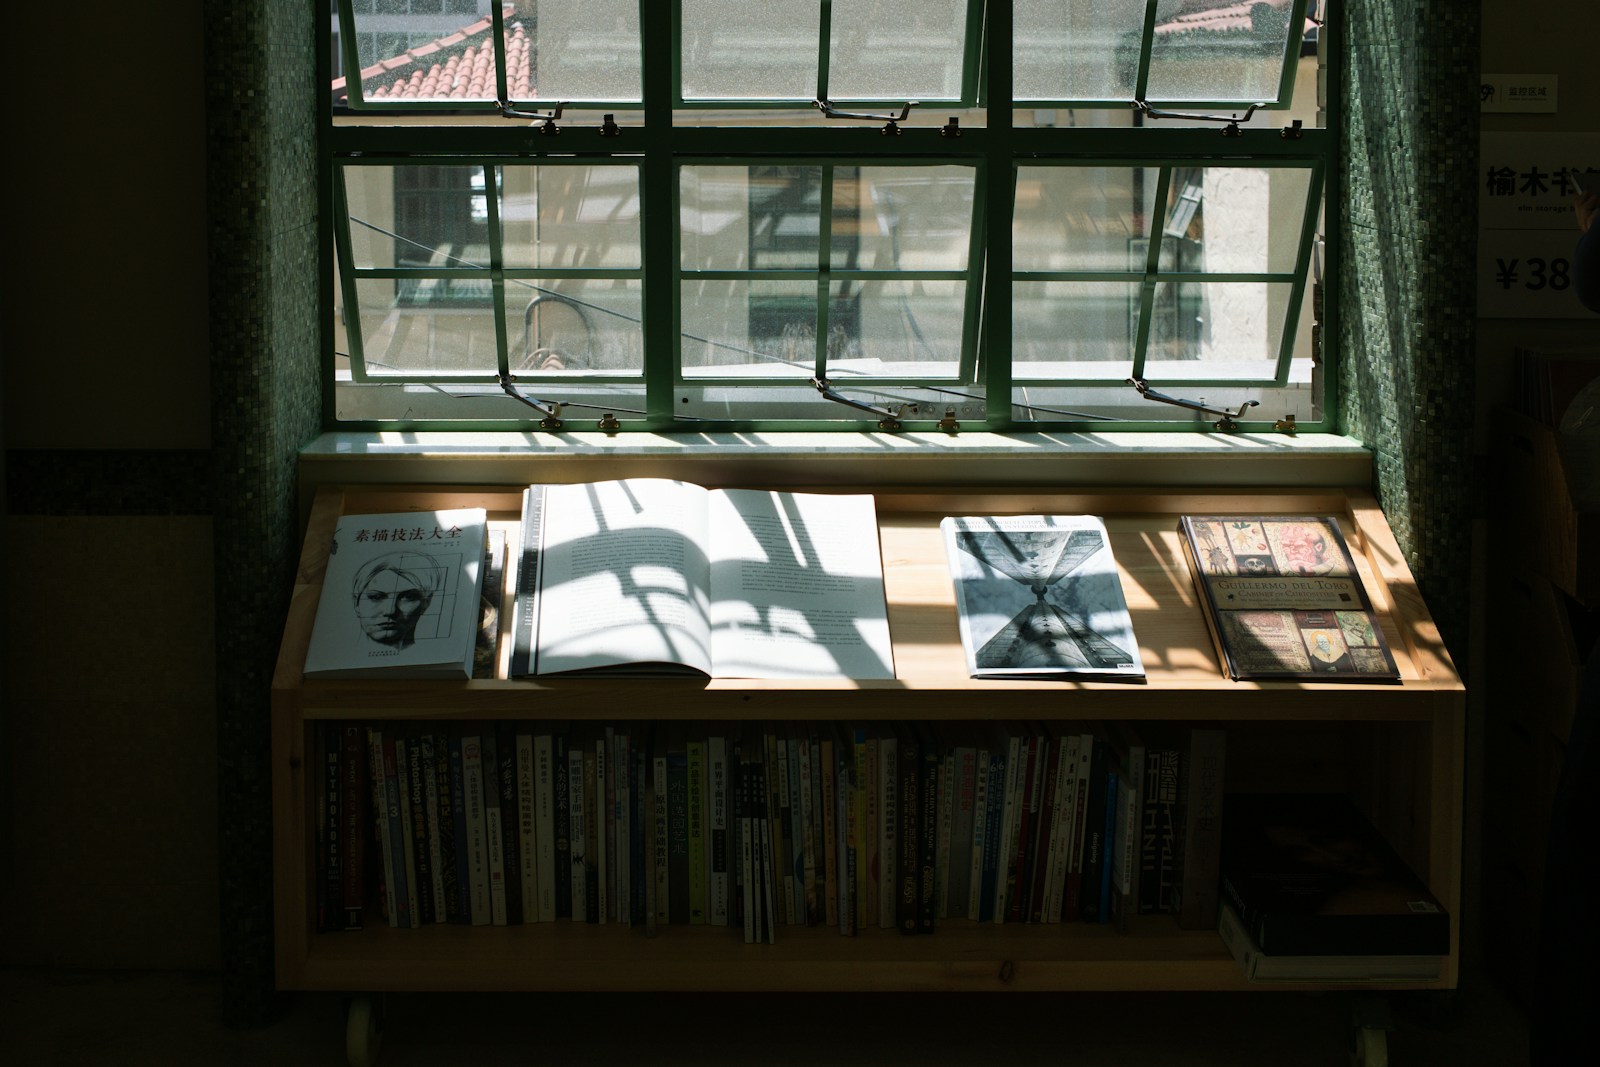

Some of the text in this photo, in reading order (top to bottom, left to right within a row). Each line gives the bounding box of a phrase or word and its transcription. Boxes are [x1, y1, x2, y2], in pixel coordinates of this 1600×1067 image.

[1508, 87, 1547, 97] 监控区域
[1486, 166, 1600, 197] 榆木书
[1536, 205, 1568, 214] storage
[353, 525, 462, 543] 素描技法大全
[1218, 580, 1349, 590] GUILLERMO DEL TORO
[990, 763, 997, 772] 6
[998, 761, 1005, 770] 6
[409, 746, 422, 804] Photoshop
[327, 752, 338, 867] MYTHOLOGY
